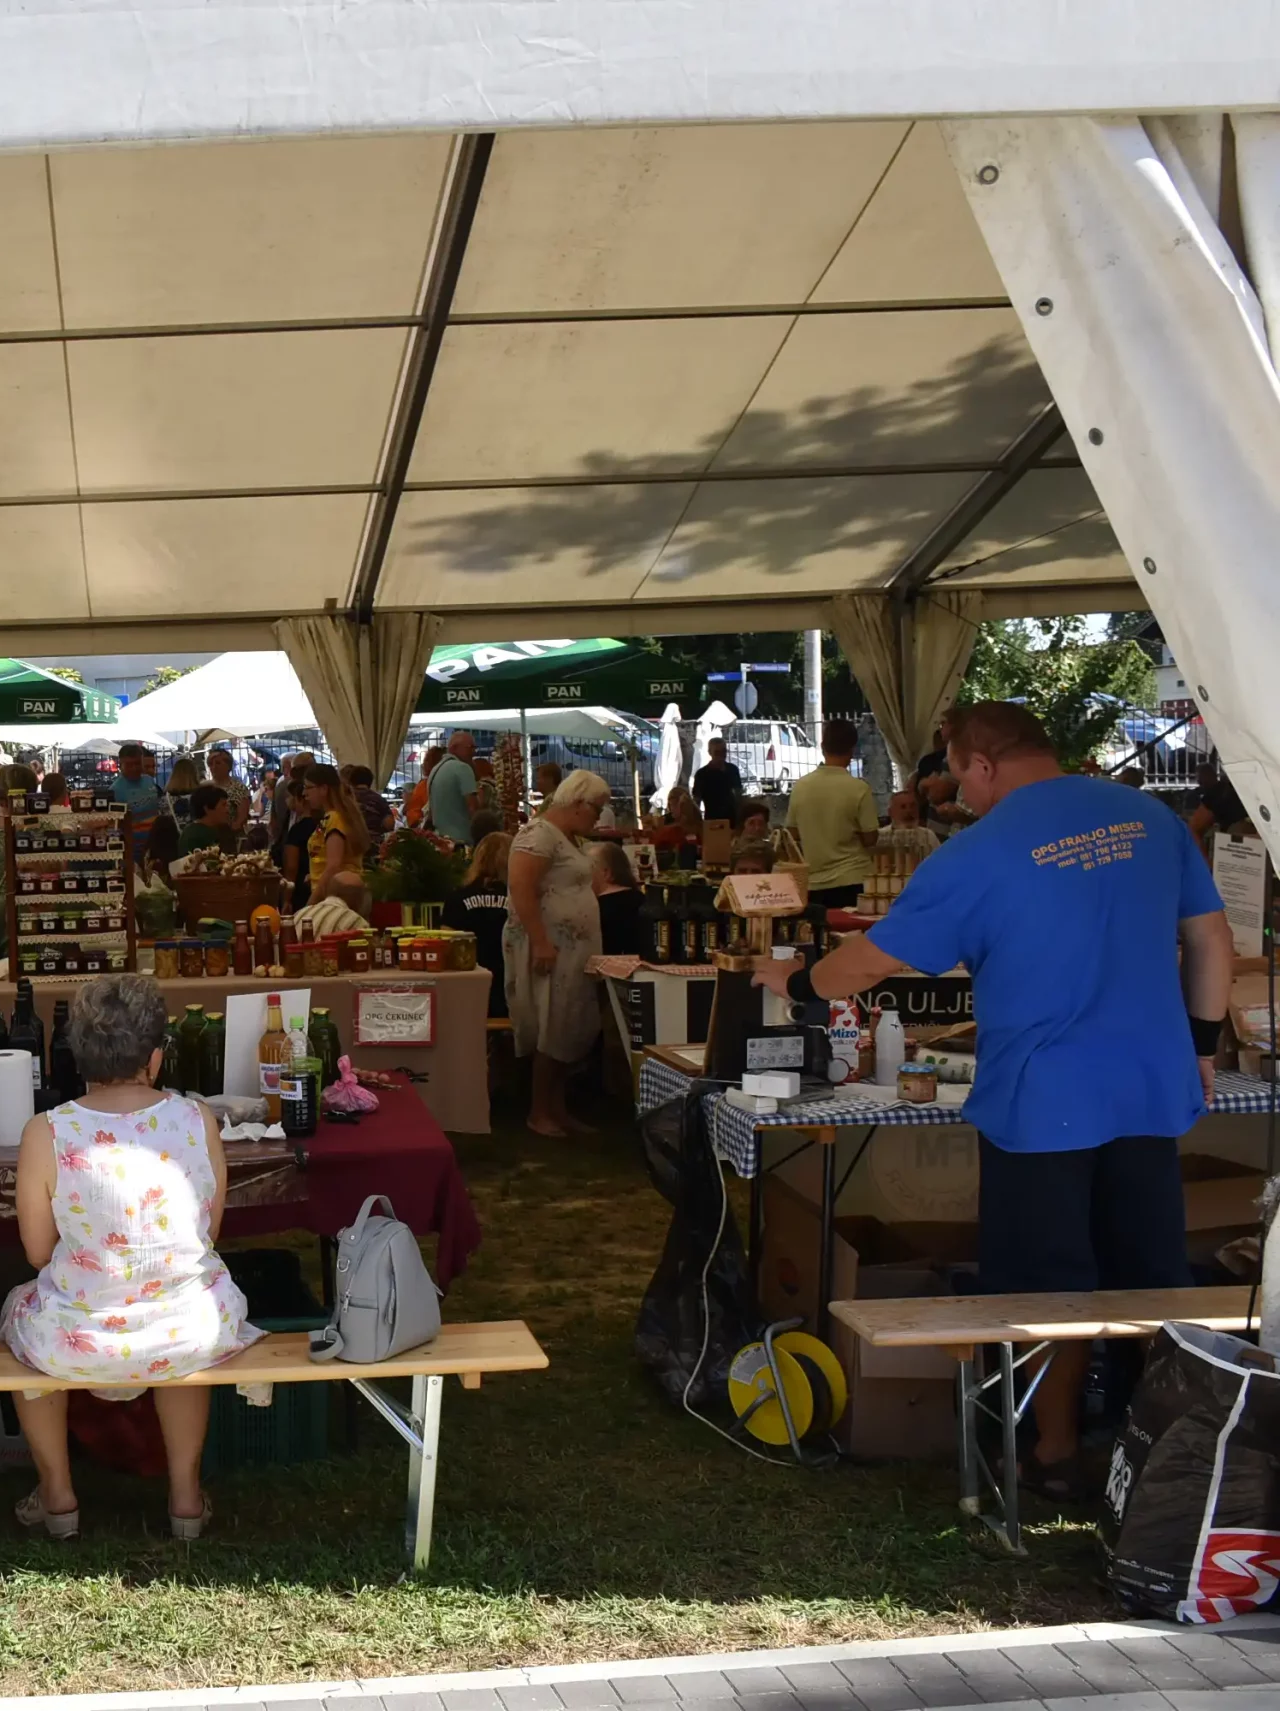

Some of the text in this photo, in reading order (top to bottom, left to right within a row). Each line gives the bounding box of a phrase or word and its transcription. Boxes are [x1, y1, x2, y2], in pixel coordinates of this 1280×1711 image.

[547, 685, 581, 697] PAN
[649, 682, 684, 694] PAN
[446, 690, 480, 702] PAN
[23, 701, 55, 713] PAN
[1031, 821, 1145, 860] OPG FRANJO MISER
[365, 1013, 383, 1021] OPG
[829, 1027, 858, 1038] Mizo
